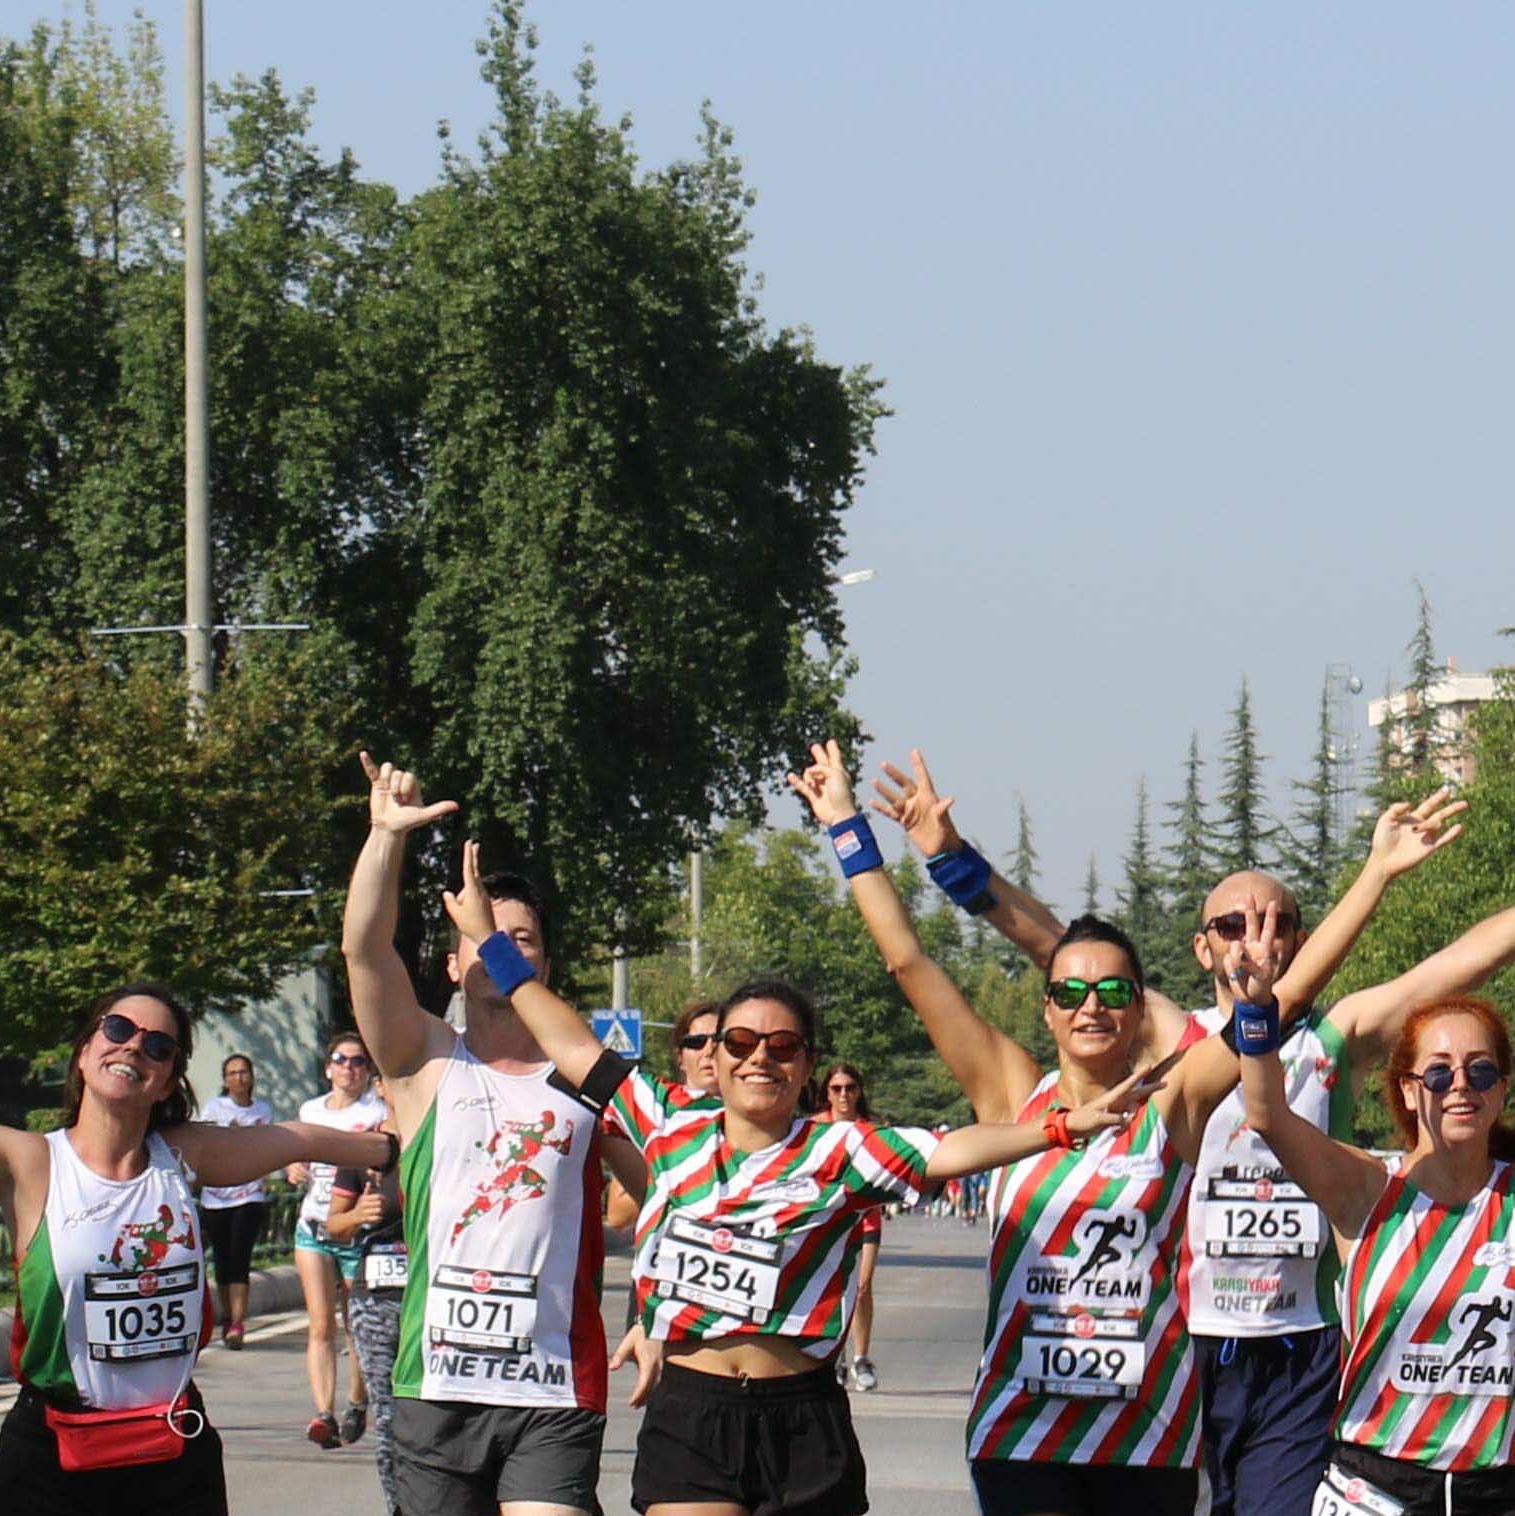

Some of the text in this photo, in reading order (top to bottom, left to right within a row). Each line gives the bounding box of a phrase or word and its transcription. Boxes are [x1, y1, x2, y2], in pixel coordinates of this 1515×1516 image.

[1225, 1209, 1302, 1238] 1265
[677, 1251, 757, 1301] 1254
[1026, 1276, 1142, 1298] ONE TEAM
[105, 1300, 186, 1341] 1035
[447, 1297, 514, 1333] 1071
[430, 1354, 566, 1386] ONE TEAM
[1040, 1346, 1126, 1380] 1029
[1400, 1363, 1442, 1383] ONE
